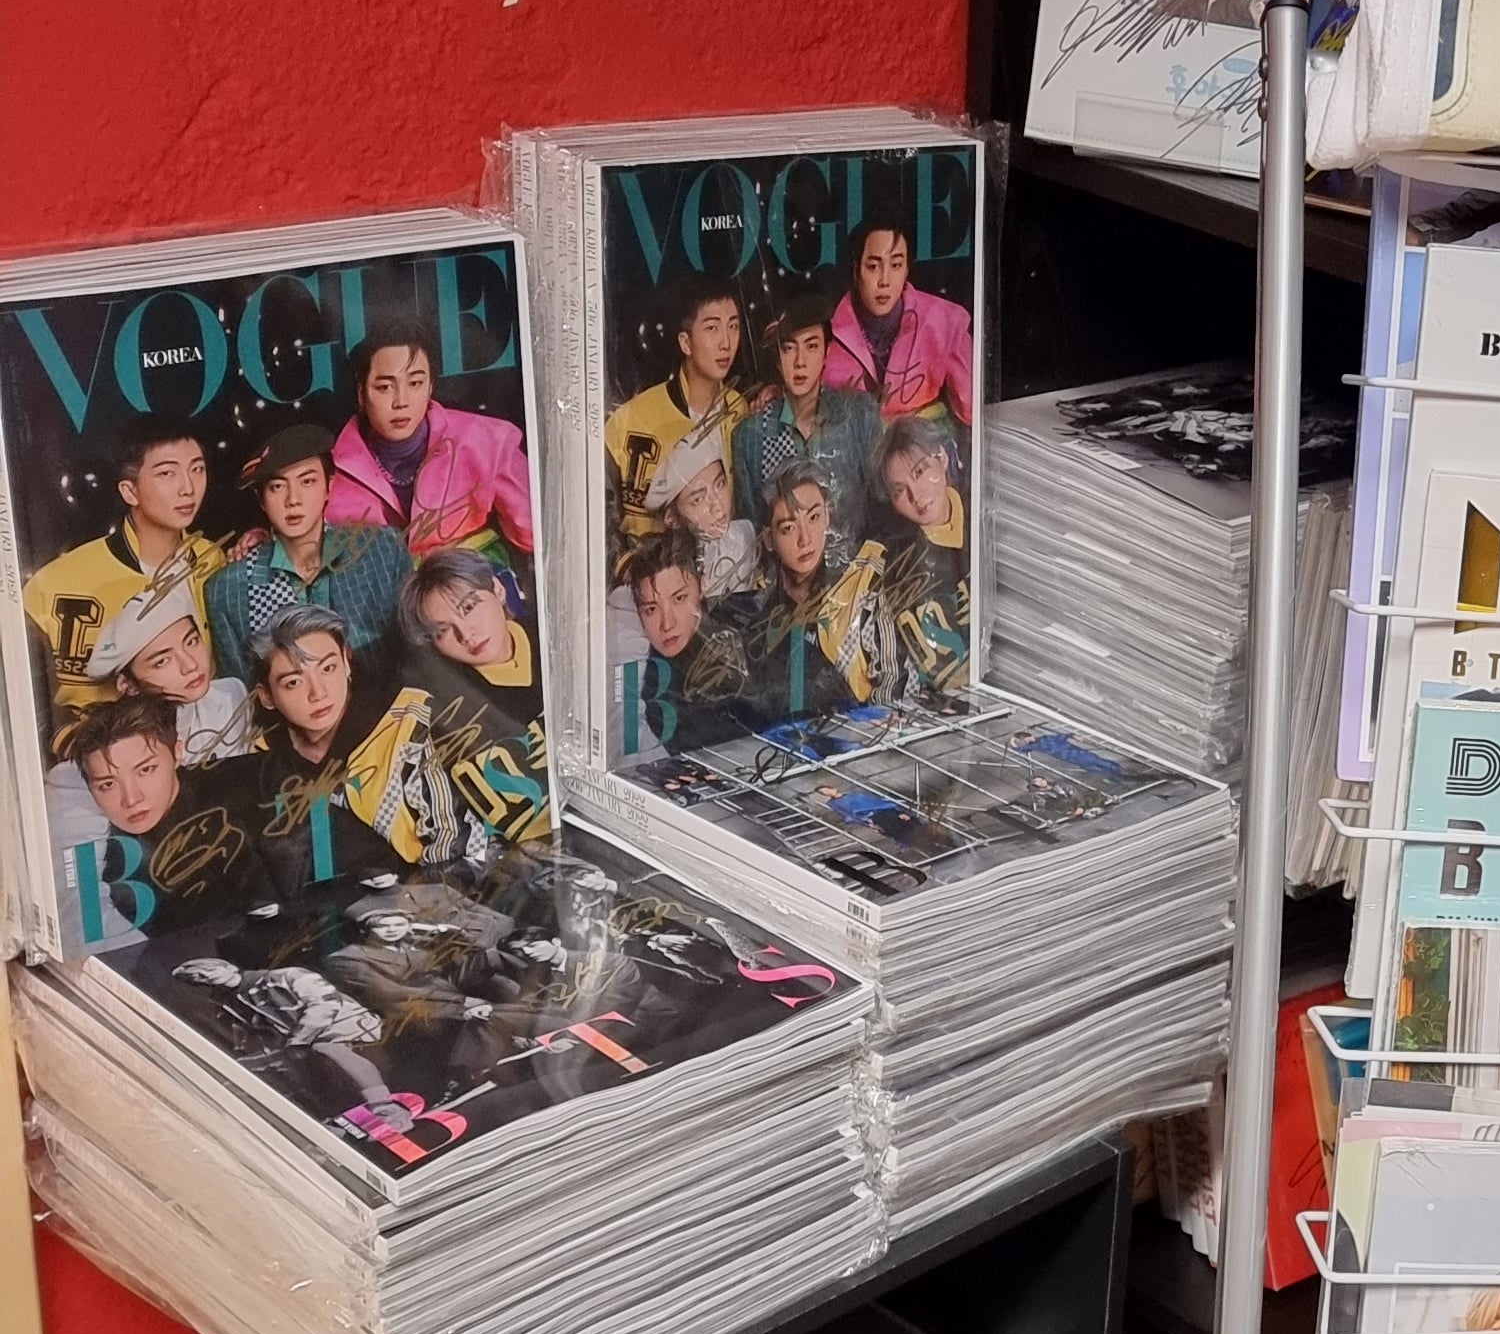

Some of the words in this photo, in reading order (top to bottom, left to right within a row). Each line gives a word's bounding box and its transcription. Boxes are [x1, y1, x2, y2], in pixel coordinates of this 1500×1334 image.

[612, 149, 972, 288] VOGUE
[701, 214, 744, 231] KOREA
[2, 248, 517, 435] VOGUE
[142, 346, 204, 368] KOREA
